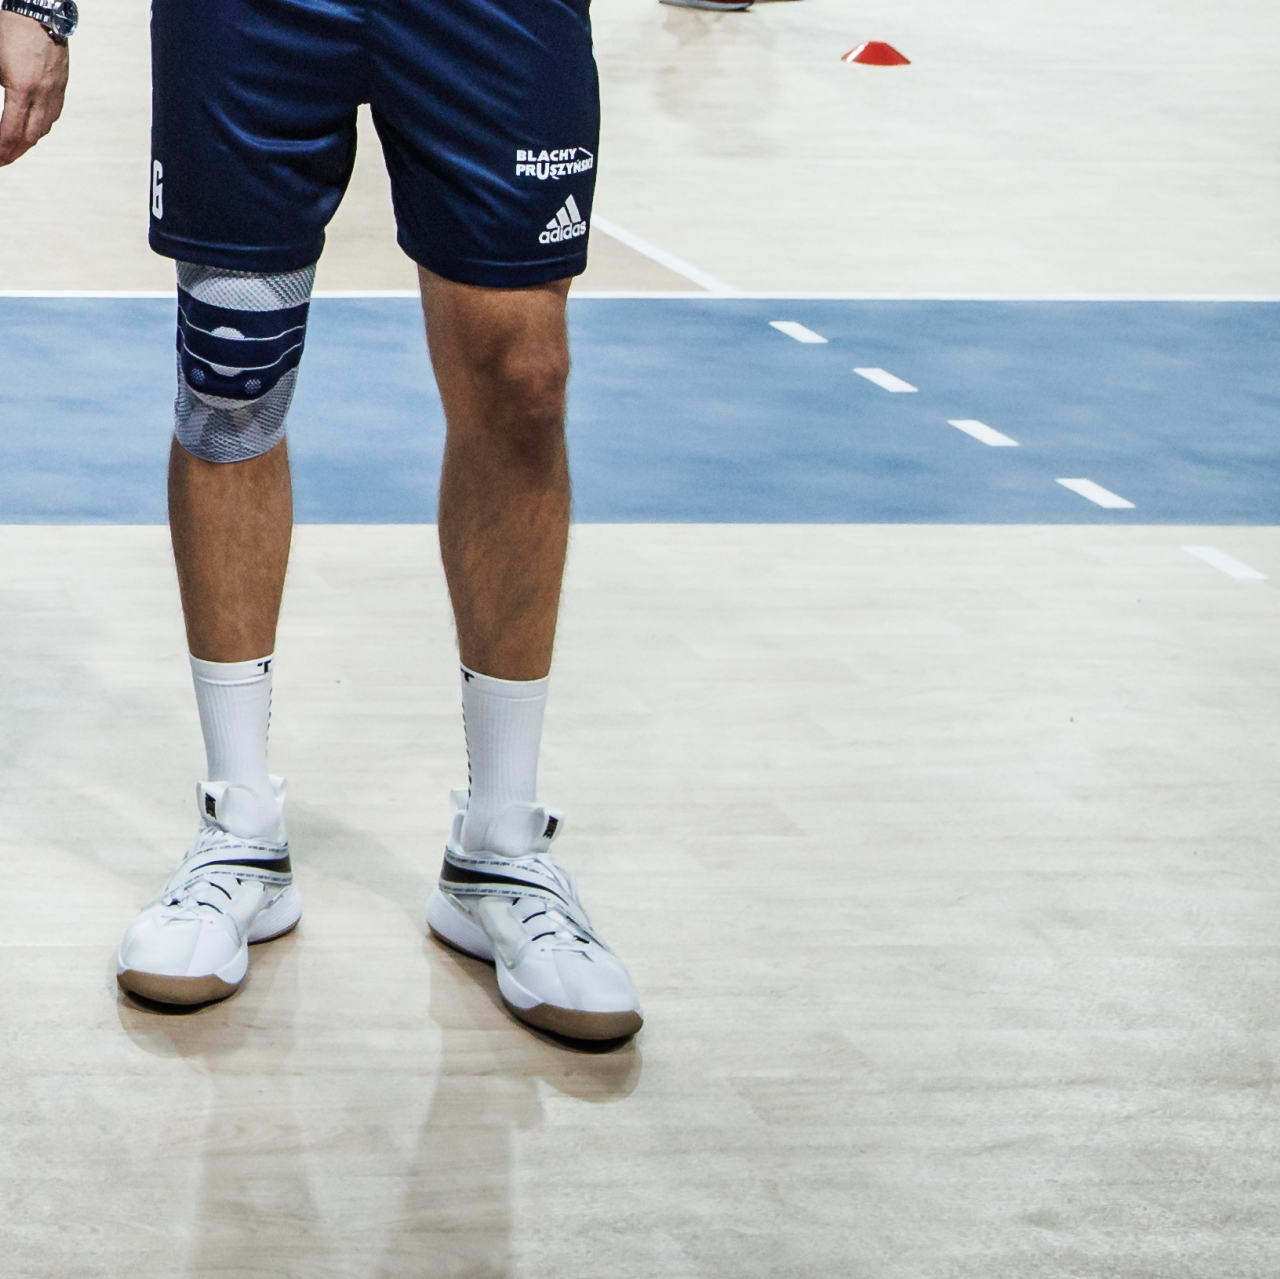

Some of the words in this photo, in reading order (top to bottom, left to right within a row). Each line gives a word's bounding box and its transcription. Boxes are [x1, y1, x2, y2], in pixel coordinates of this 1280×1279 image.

[516, 147, 578, 162] BLACHY
[515, 157, 593, 180] PRUSZYŃSKI
[538, 220, 587, 244] adidas
